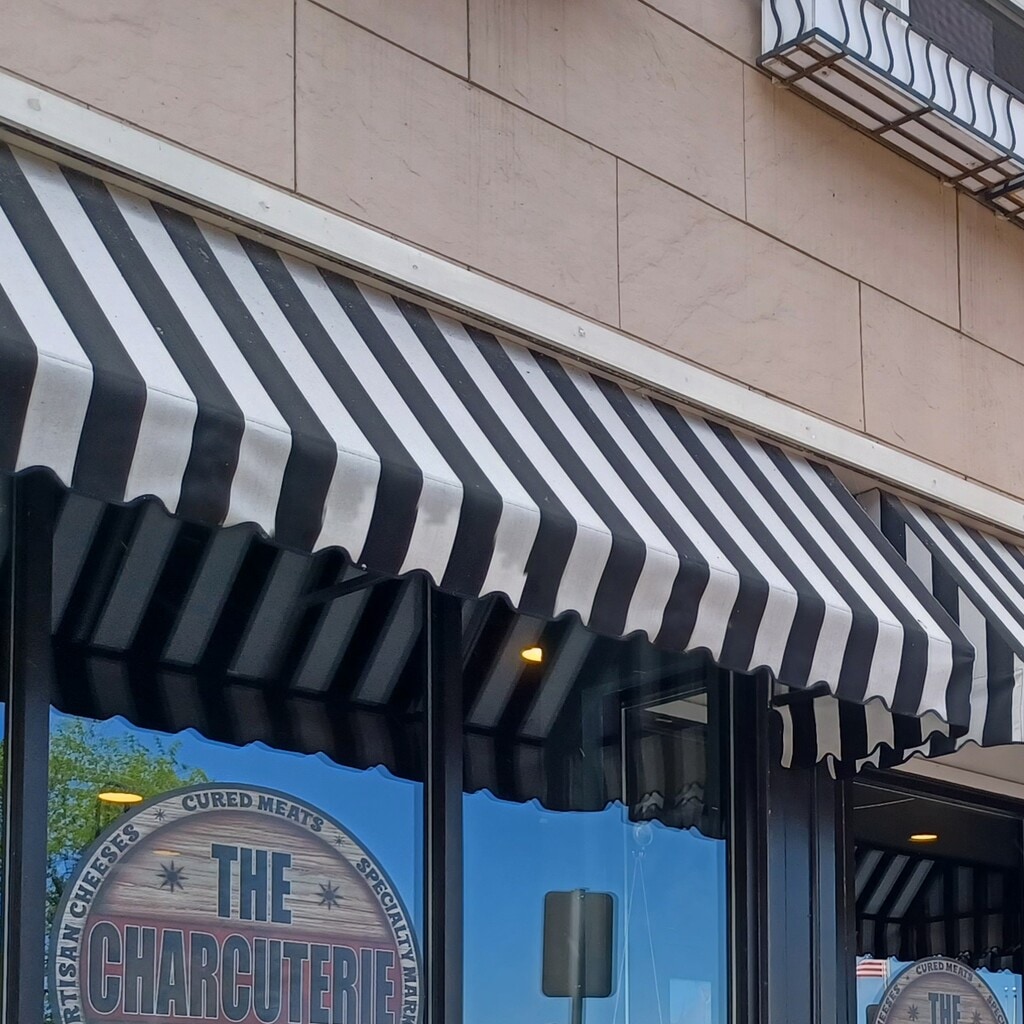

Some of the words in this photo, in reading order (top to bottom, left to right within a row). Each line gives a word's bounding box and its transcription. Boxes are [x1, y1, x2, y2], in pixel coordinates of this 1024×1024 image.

[181, 790, 254, 813] CURED
[257, 795, 325, 834] MEATS
[69, 823, 141, 919] CHEESES
[210, 843, 293, 925] THE
[356, 857, 415, 962] SPECIALTY
[915, 961, 944, 975] CURED
[945, 963, 974, 982] MEATS
